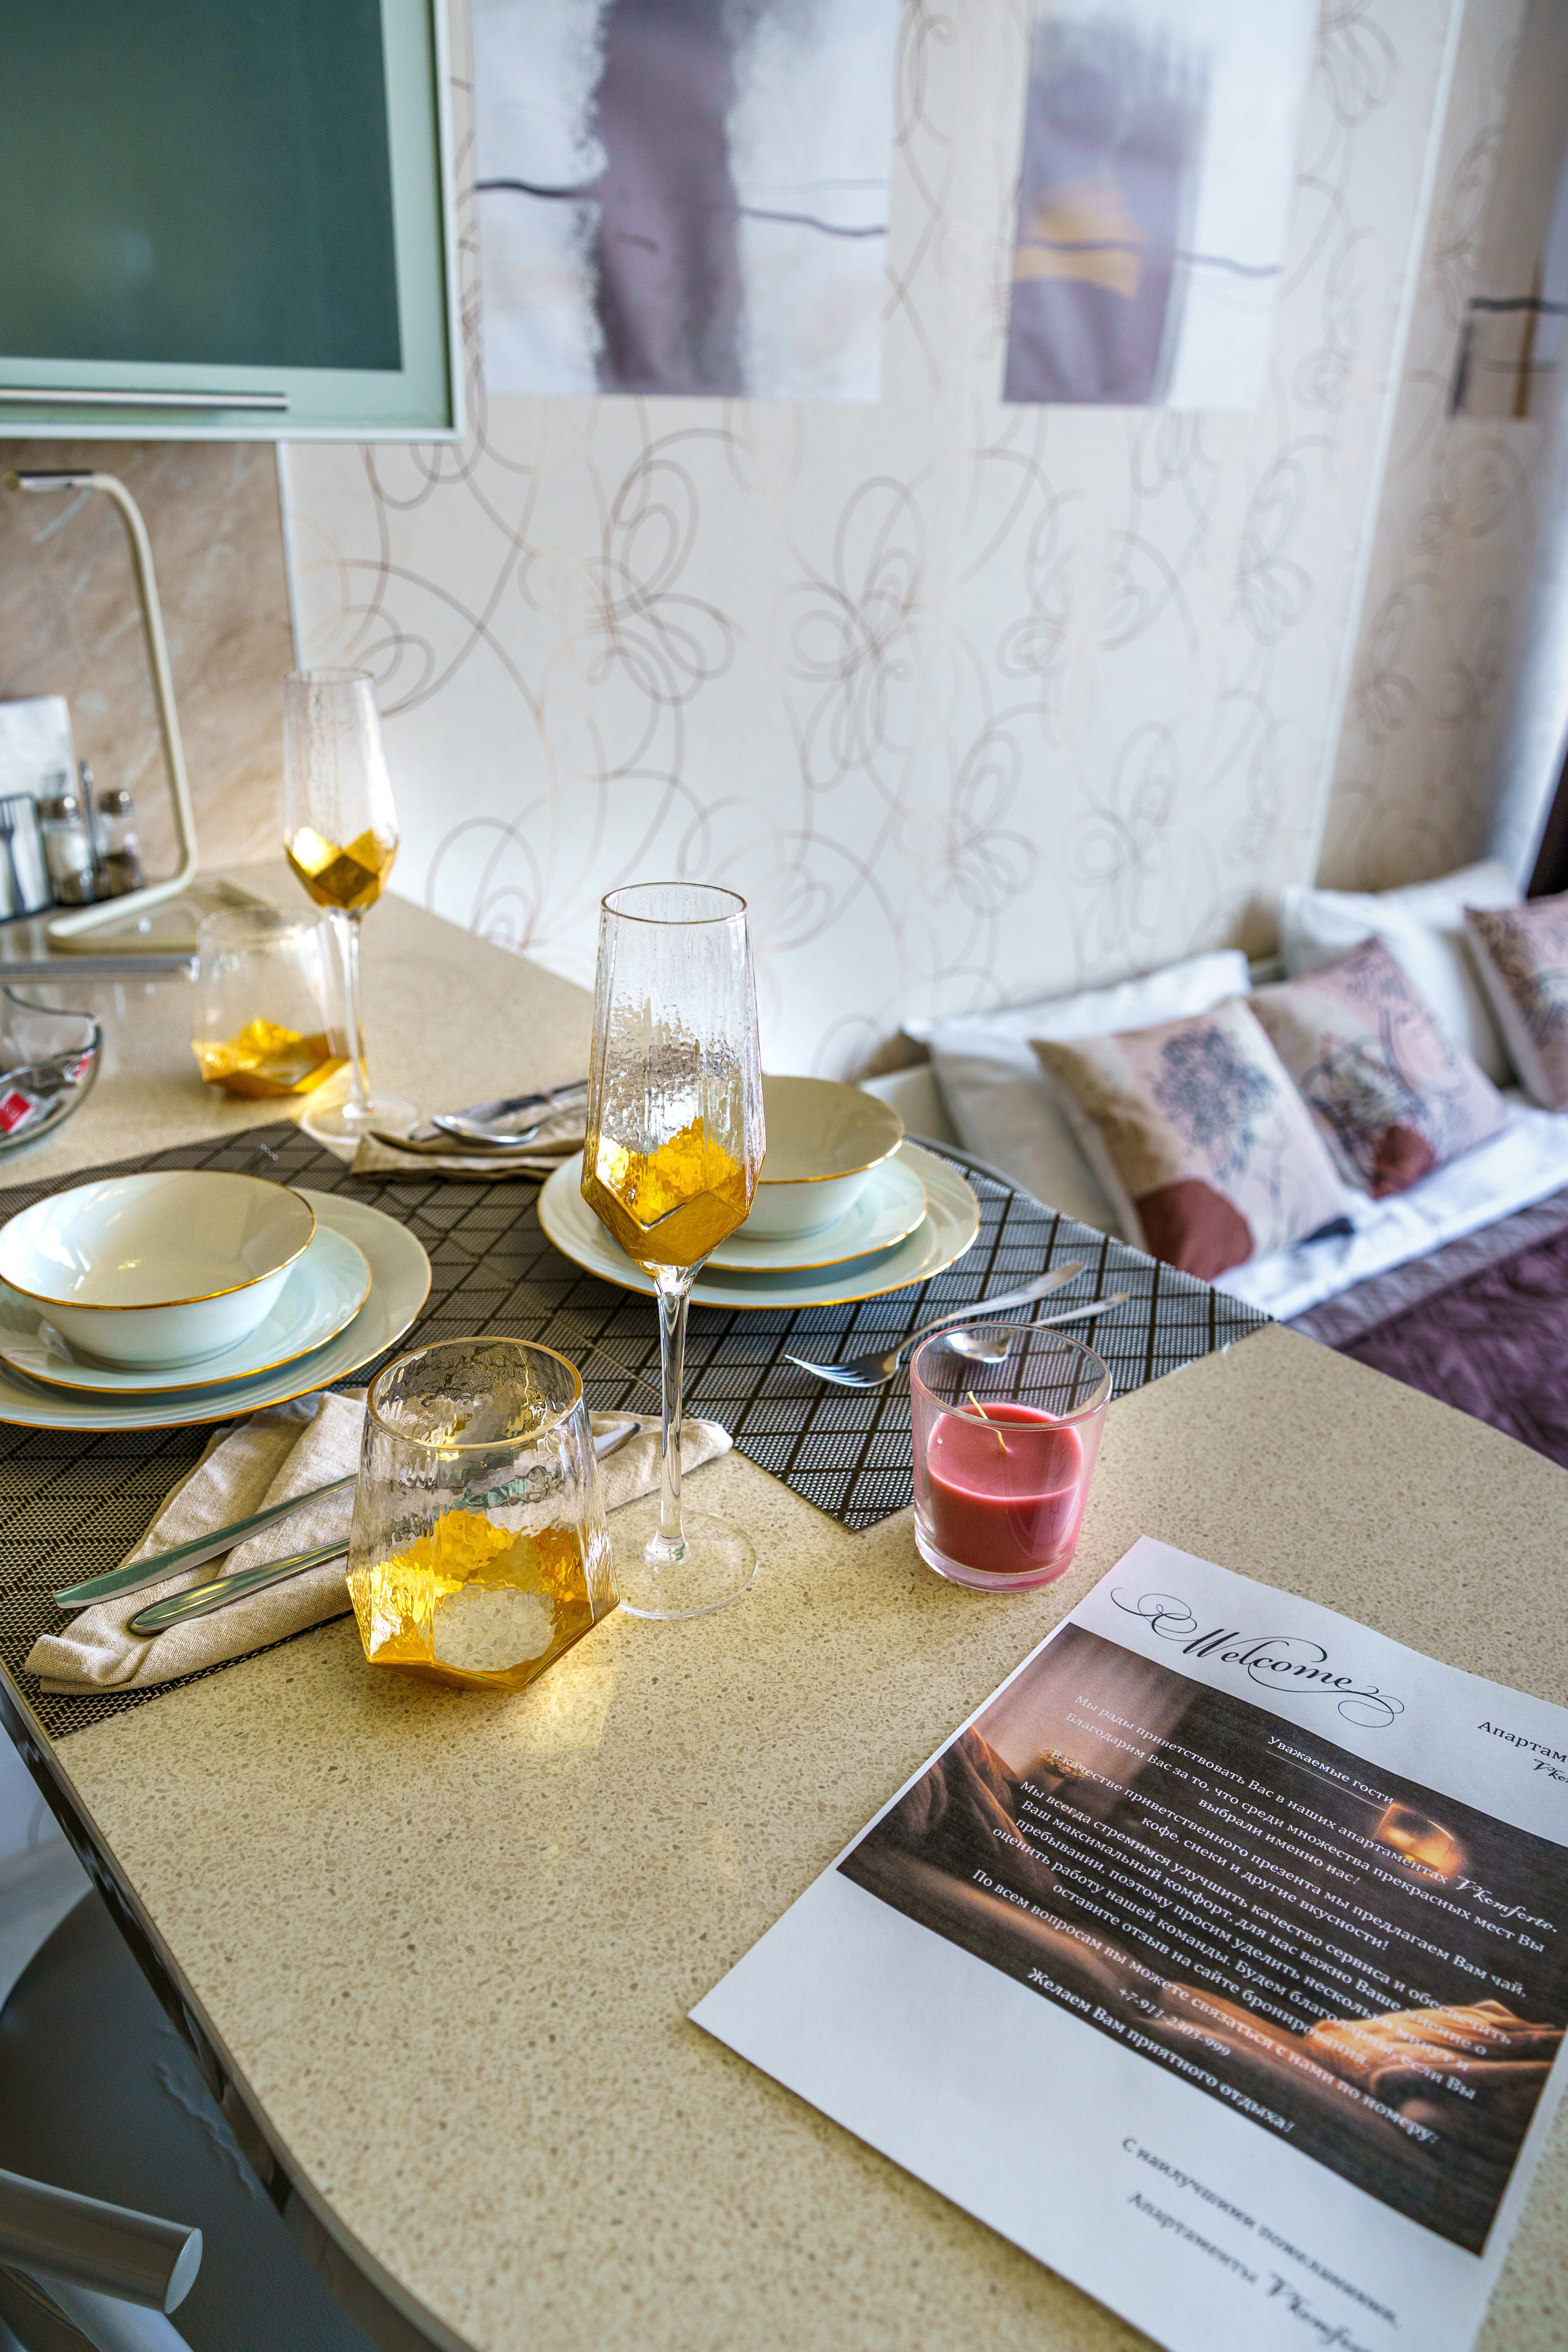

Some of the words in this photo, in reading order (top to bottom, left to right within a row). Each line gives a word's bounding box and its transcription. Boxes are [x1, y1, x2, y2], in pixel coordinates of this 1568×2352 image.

[1110, 1588, 1405, 1728] Welcome
[1477, 1722, 1567, 1763] Апартам
[1065, 1713, 1145, 1758] Благодарим
[1147, 1754, 1172, 1770] Вас
[1173, 1768, 1188, 1779] за
[1192, 1776, 1211, 1792] то,
[1215, 1788, 1238, 1804] что
[1242, 1803, 1284, 1827] среди
[1287, 1825, 1370, 1870] множества
[1373, 1868, 1471, 1919] прекрасных
[1474, 1917, 1515, 1939] мест
[1518, 1934, 1544, 1951] Вы
[1075, 1696, 1098, 1711] Мы
[1098, 1709, 1134, 1729] рады
[1134, 1726, 1245, 1784] приветствовать
[1248, 1780, 1273, 1797] Вас
[1287, 1801, 1336, 1829] наших
[1339, 1828, 1448, 1883] апартаментах
[1199, 1800, 1262, 1836] выбрали
[1265, 1834, 1322, 1866] именно
[1326, 1864, 1360, 1884] нас!
[1268, 1736, 1349, 1782] Уважаемые
[1352, 1781, 1394, 1804] гости
[1533, 1758, 1568, 1783] Vko
[1015, 1820, 1106, 1873] пребывании,
[1109, 1870, 1172, 1907] поэтому
[1174, 1905, 1231, 1941] просим
[1232, 1938, 1299, 1978] уделить
[1303, 1976, 1394, 2031] несколько
[1020, 1782, 1044, 1798] Мы
[1046, 1796, 1091, 1823] всегда
[1094, 1822, 1171, 1866] стремимся
[1170, 1863, 1247, 1907] улучшить
[1251, 1905, 1322, 1946] качество
[1326, 1945, 1390, 1983] сервиса
[1394, 1981, 1406, 1991] и
[1022, 1801, 1051, 1820] Ваш
[1053, 1819, 1161, 1880] максимальный
[1163, 1876, 1235, 1922] комфорт,
[1235, 1919, 1267, 1938] для
[1270, 1936, 1298, 1954] нас
[1300, 1951, 1352, 1983] важно
[1355, 1979, 1400, 2013] Ваше
[1474, 2045, 1486, 2054] о
[1050, 1748, 1063, 1759] В
[1061, 1755, 1122, 1791] качестве
[1125, 1789, 1248, 1856] приветственного
[1251, 1855, 1321, 1894] презента
[1324, 1893, 1349, 1909] мы
[1353, 1906, 1449, 1959] предлагаем
[1453, 1955, 1487, 1978] Вам
[1491, 1973, 1526, 1997] чай,
[1054, 1885, 1119, 1924] оставите
[1122, 1924, 1169, 1953] отзыв
[1172, 1951, 1191, 1966] на
[1194, 1965, 1239, 1992] сайте
[1140, 1817, 1181, 1844] кофе,
[1184, 1841, 1227, 1866] снеки
[1230, 1864, 1240, 1873] и
[1241, 1872, 1296, 1902] другие
[1300, 1900, 1389, 1950] вкусности!
[973, 1870, 992, 1886] По
[994, 1885, 1029, 1908] всем
[1031, 1905, 1102, 1950] вопросам
[1104, 1947, 1127, 1964] вы
[1129, 1961, 1189, 2000] можете
[1192, 1999, 1275, 2049] связаться
[1276, 2044, 1288, 2056] с
[1289, 2051, 1334, 2084] нами
[1336, 2081, 1360, 2098] по
[993, 1830, 1049, 1864] оценить
[1051, 1862, 1104, 1893] работу
[1106, 1891, 1155, 1921] нашей
[1158, 1919, 1230, 1965] команды.
[1235, 1960, 1286, 1995] Будем
[1447, 2076, 1475, 2098] Вы
[1028, 1968, 1091, 2011] Желаем
[1093, 2007, 1126, 2033] Вам
[1128, 2030, 1218, 2086] приятного
[1220, 2084, 1294, 2132] отдыха!
